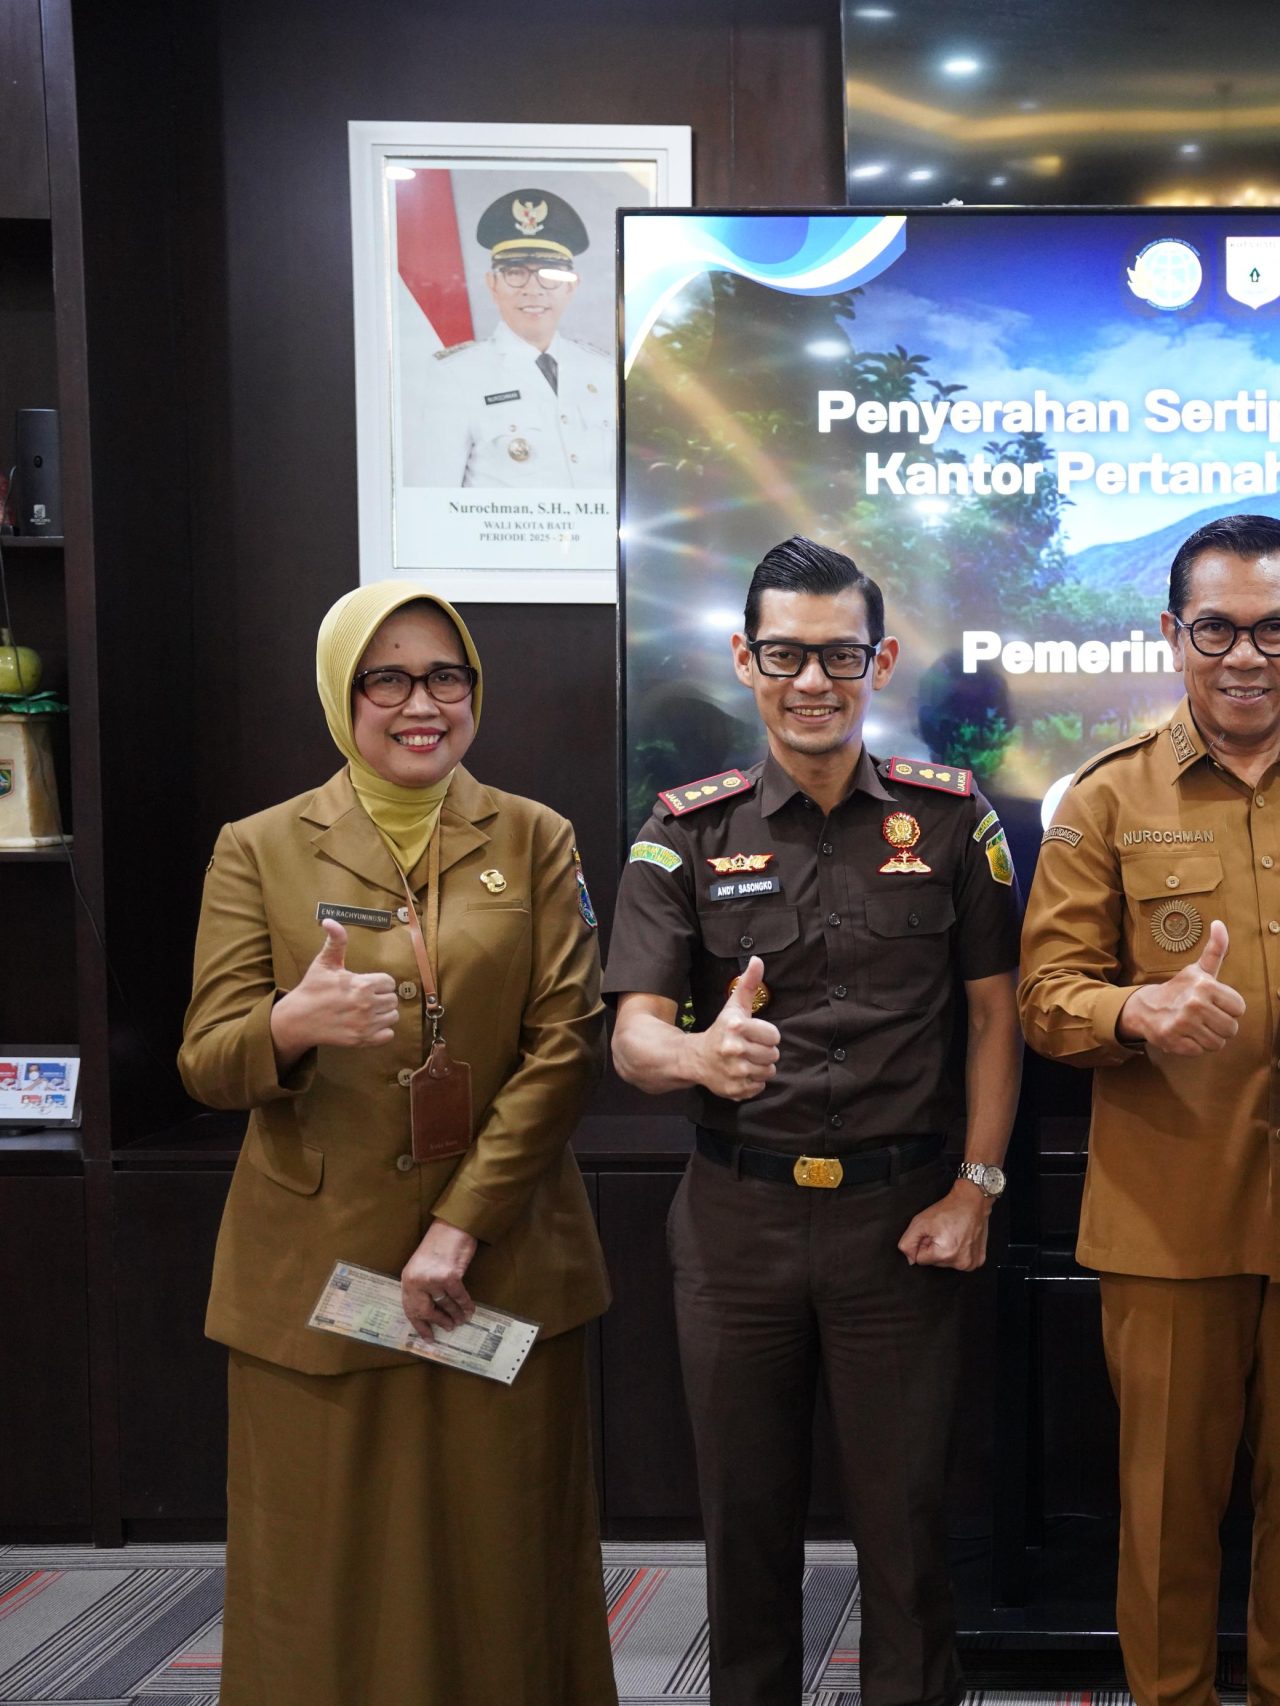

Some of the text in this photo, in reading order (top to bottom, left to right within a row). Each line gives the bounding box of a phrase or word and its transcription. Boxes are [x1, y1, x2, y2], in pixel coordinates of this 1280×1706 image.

[818, 389, 1130, 443] Penyerahan
[865, 452, 1044, 498] Kantor
[449, 501, 610, 515] Nurochman, S.H., M.H.
[484, 521, 575, 530] WALI KOTA BATU
[479, 533, 526, 542] PERIODE
[530, 533, 550, 542] 2025
[962, 630, 1173, 674] Pemerin
[957, 771, 967, 791] JAKSA
[665, 792, 686, 811] JAKSA
[1123, 830, 1214, 846] NUROCHMAN
[717, 881, 773, 897] ANDY SASONGKO
[321, 908, 336, 916] ENY
